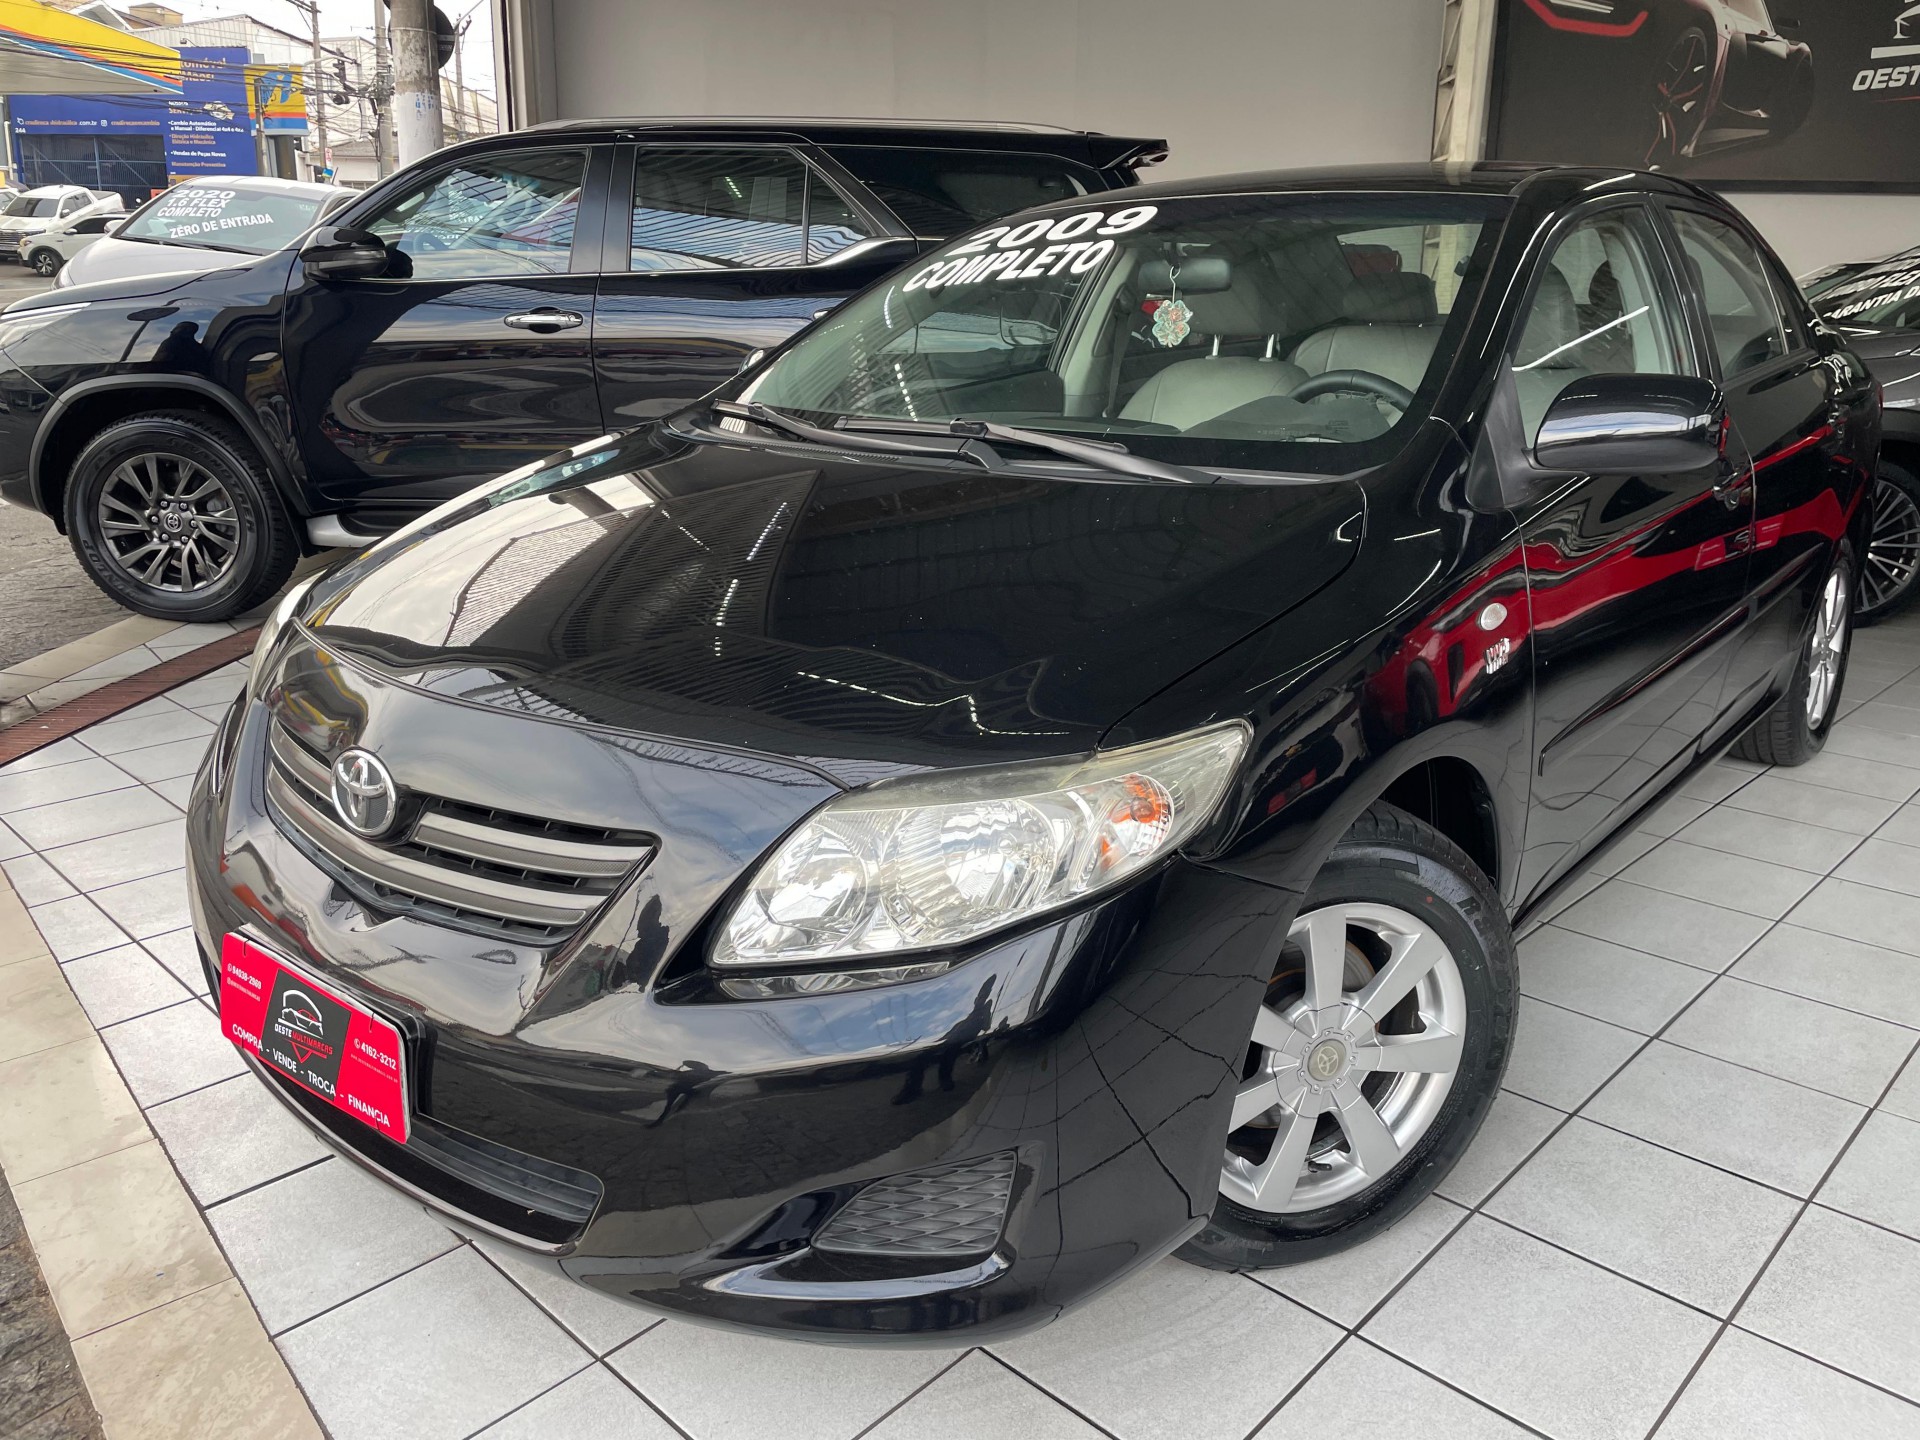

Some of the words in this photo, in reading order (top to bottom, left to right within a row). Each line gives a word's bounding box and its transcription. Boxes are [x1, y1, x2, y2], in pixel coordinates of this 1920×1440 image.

[167, 197, 186, 207] 1.6
[190, 198, 231, 208] FLEX
[172, 189, 236, 199] 2020
[157, 207, 222, 218] COMPLETO
[202, 221, 219, 232] DE
[221, 213, 274, 229] ENTRADA
[944, 205, 1158, 258] 2009
[902, 239, 1115, 292] COMPLETO
[361, 1042, 397, 1070] 4162-3212
[232, 1024, 264, 1052] COMPRA
[273, 1048, 297, 1073] VENDE
[307, 1070, 336, 1096] TROCA
[348, 1094, 391, 1127] FINANCIA
